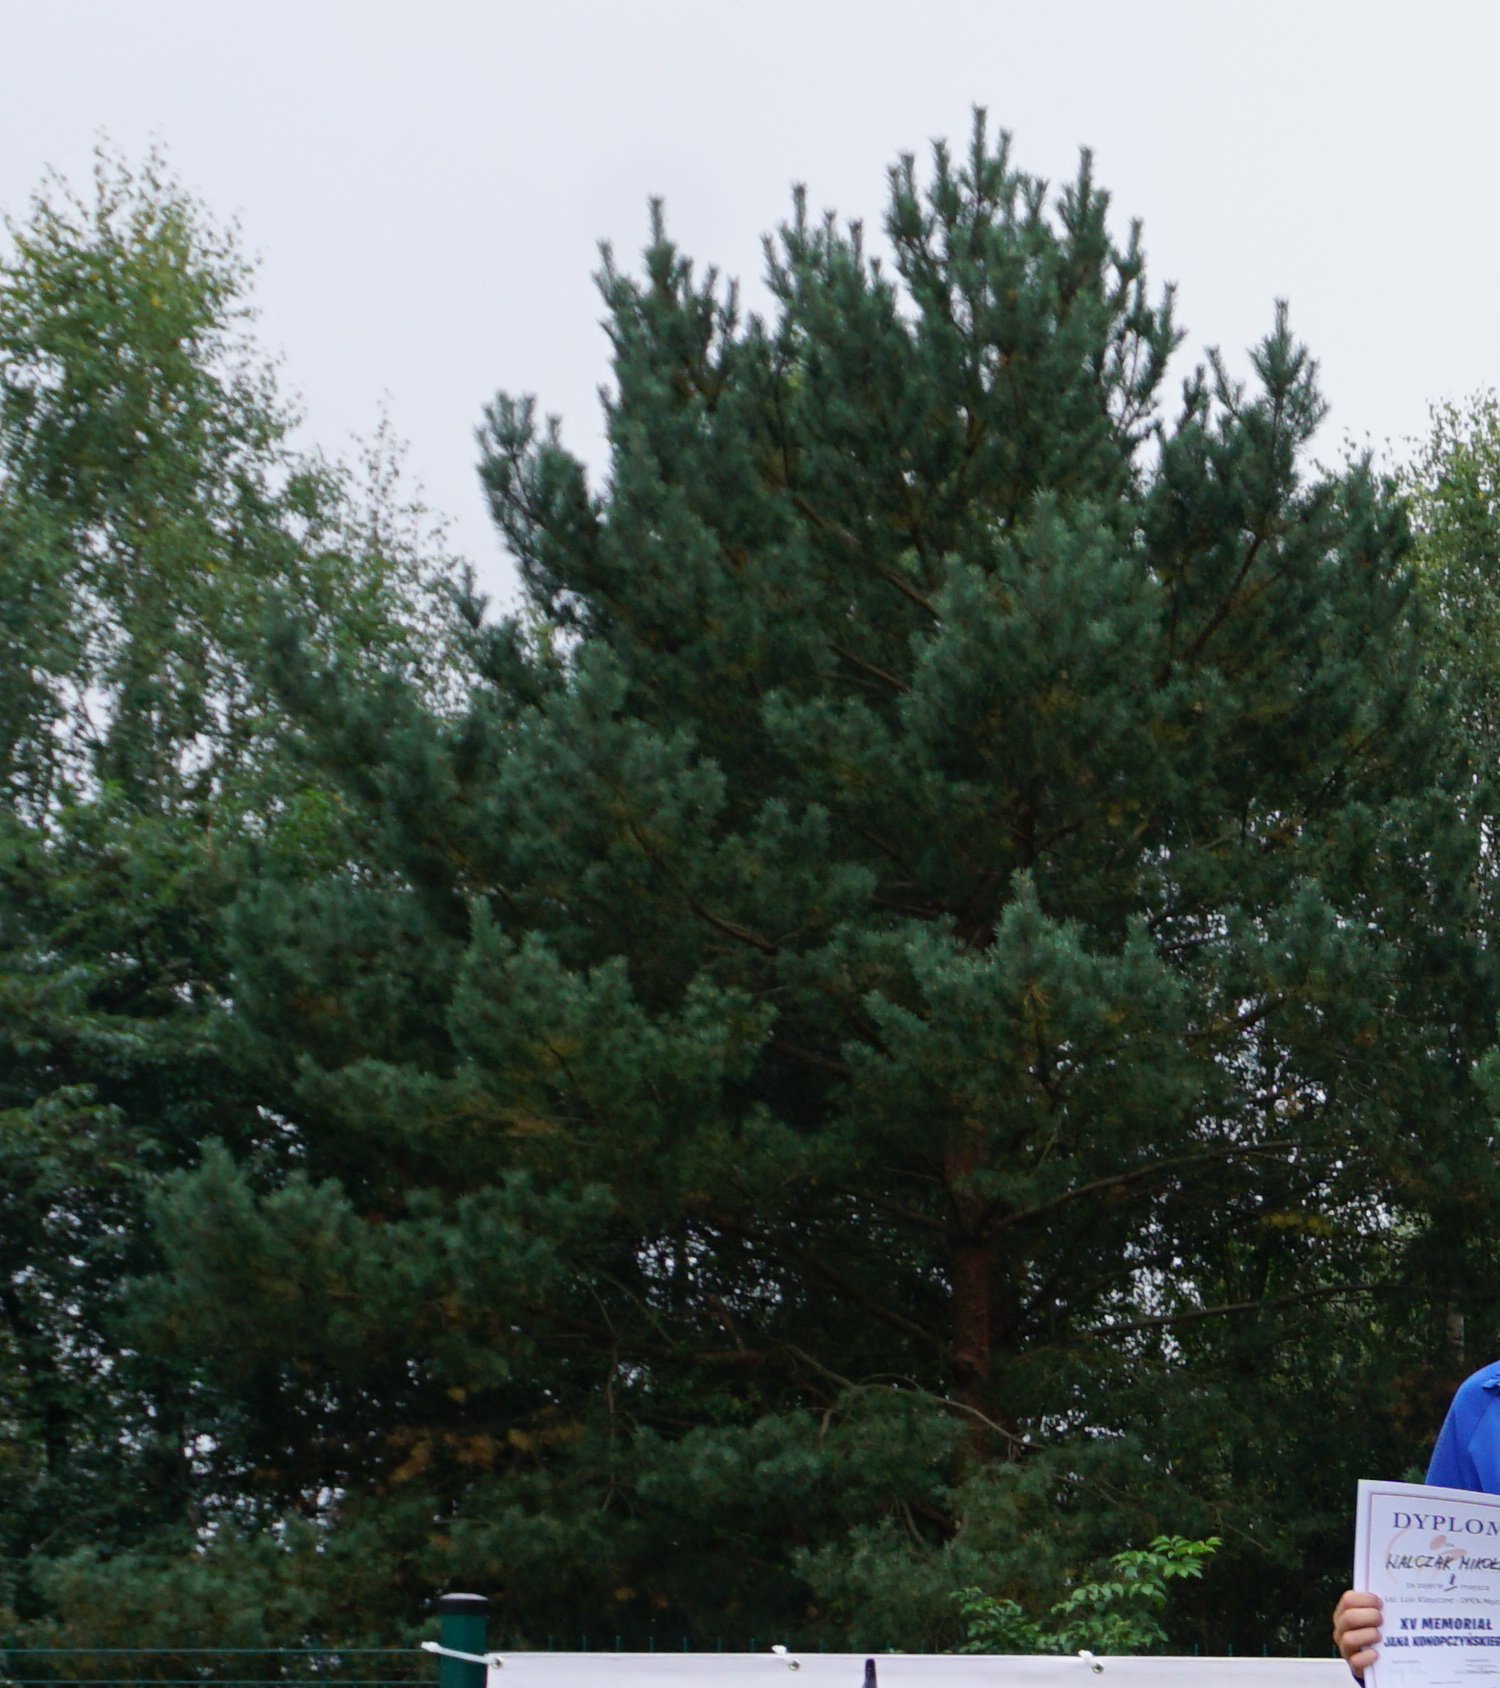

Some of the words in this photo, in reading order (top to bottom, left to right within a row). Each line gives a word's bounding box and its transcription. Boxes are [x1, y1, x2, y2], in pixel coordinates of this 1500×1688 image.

[1400, 1618, 1417, 1631] XV
[1422, 1618, 1493, 1631] MEMORIAŁ
[1384, 1635, 1410, 1647] JANA
